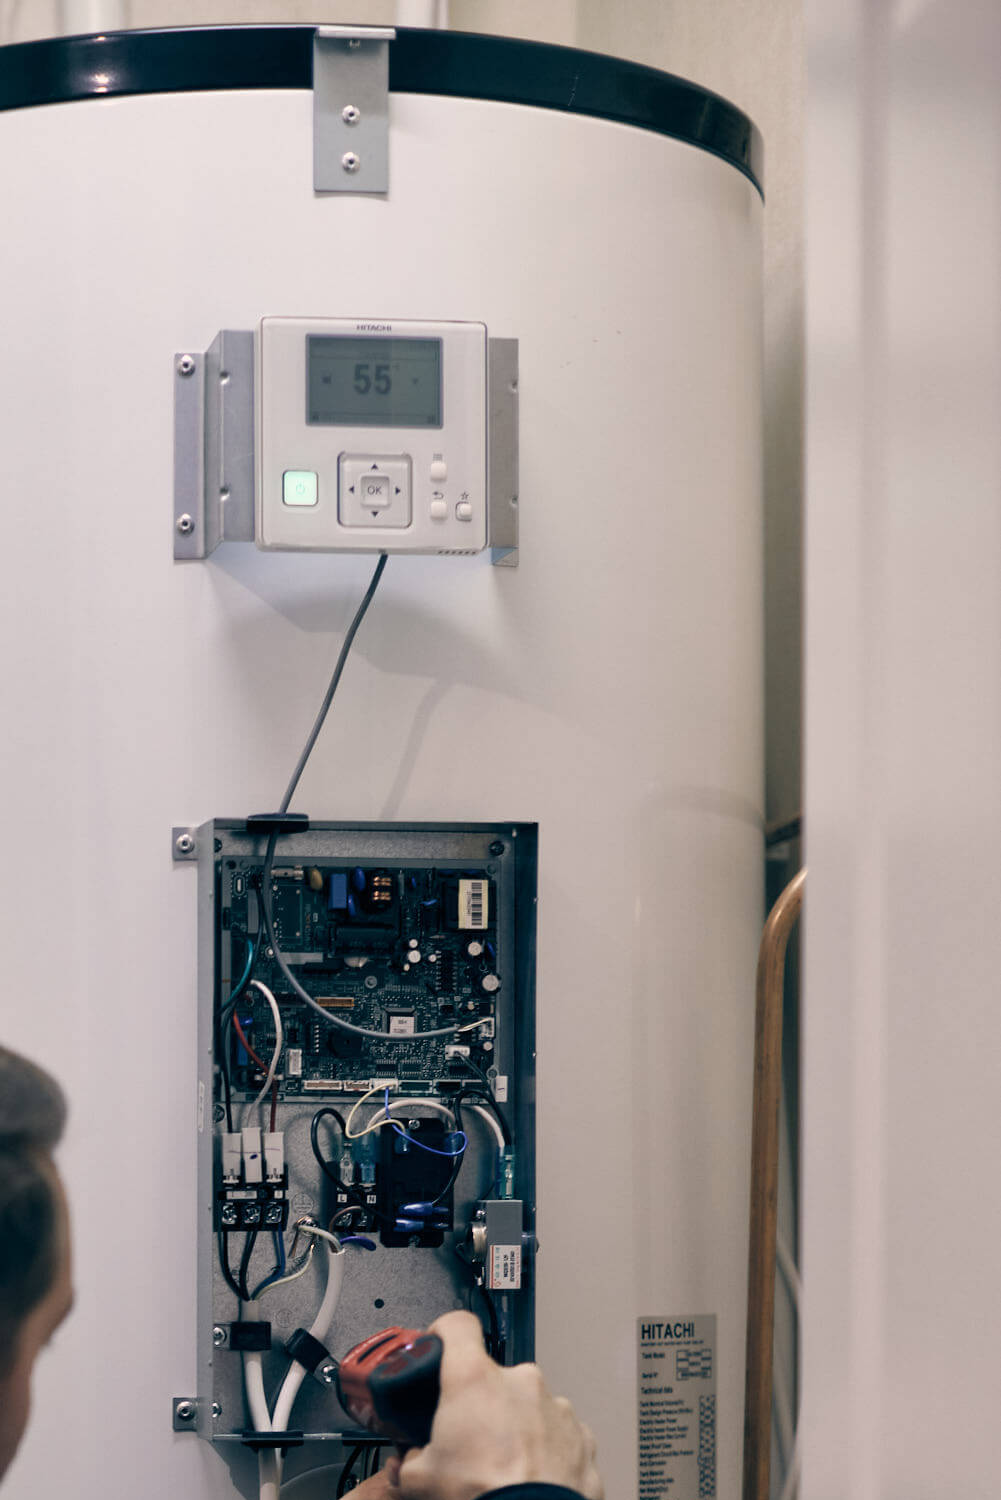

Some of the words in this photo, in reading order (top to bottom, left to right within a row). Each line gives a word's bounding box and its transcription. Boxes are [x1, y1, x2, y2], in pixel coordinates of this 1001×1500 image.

[353, 363, 392, 395] 55
[367, 485, 382, 496] OK
[641, 1322, 695, 1340] HITACHI
